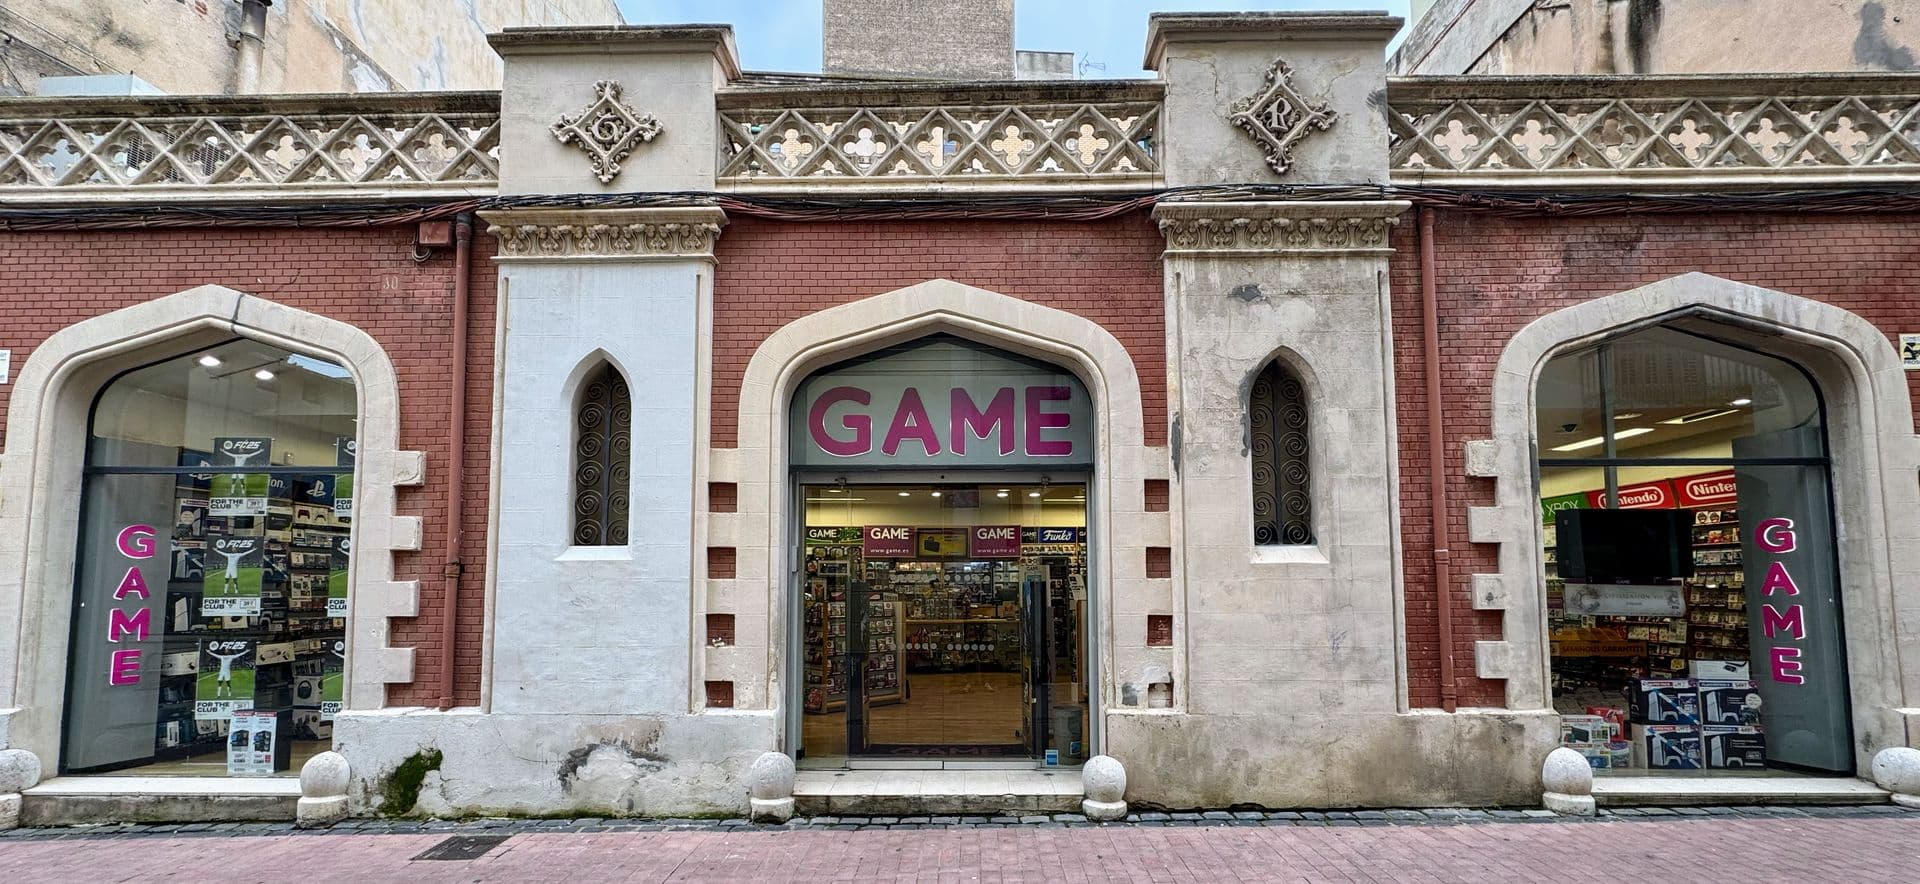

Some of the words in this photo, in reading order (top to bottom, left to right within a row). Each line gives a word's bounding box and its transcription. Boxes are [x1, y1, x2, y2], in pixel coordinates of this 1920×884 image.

[808, 386, 1073, 457] GAME
[1602, 492, 1658, 506] ntendo
[809, 529, 837, 538] GAME
[870, 528, 909, 540] GAME
[977, 528, 1015, 540] GAME
[1043, 529, 1073, 541] Funko
[108, 524, 158, 686] GAME
[1754, 518, 1806, 685] GAME
